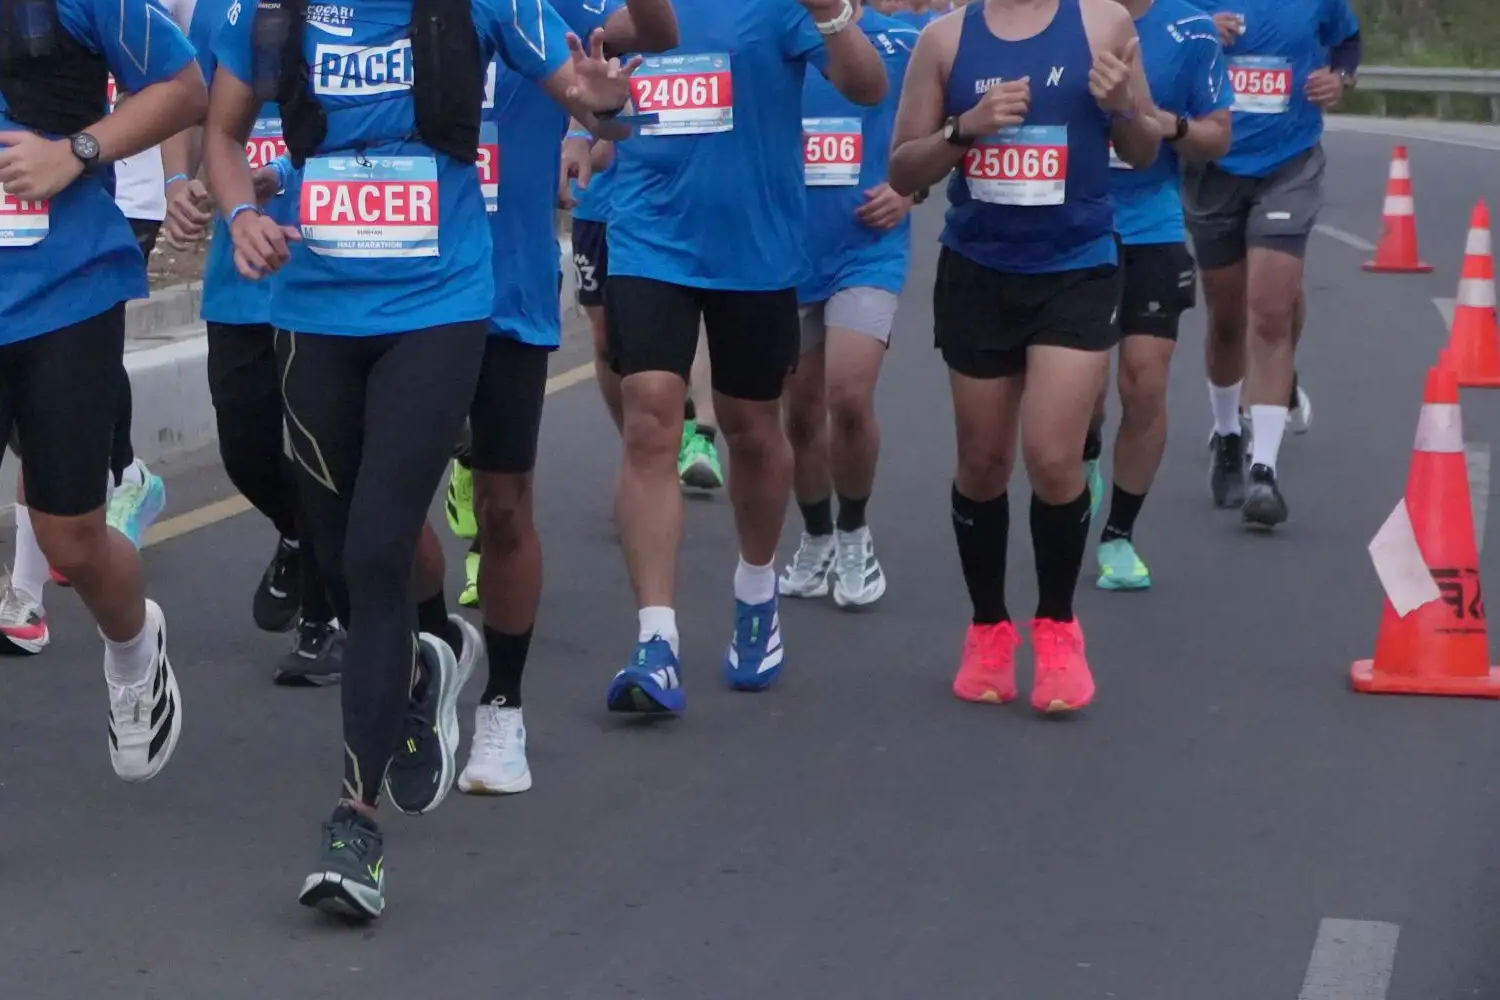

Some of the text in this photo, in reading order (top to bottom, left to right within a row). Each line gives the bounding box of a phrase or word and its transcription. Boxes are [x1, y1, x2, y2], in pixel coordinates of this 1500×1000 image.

[637, 76, 719, 108] 24061
[967, 147, 1060, 178] 25066
[310, 184, 432, 222] PACER
[358, 240, 403, 249] MARATHON
